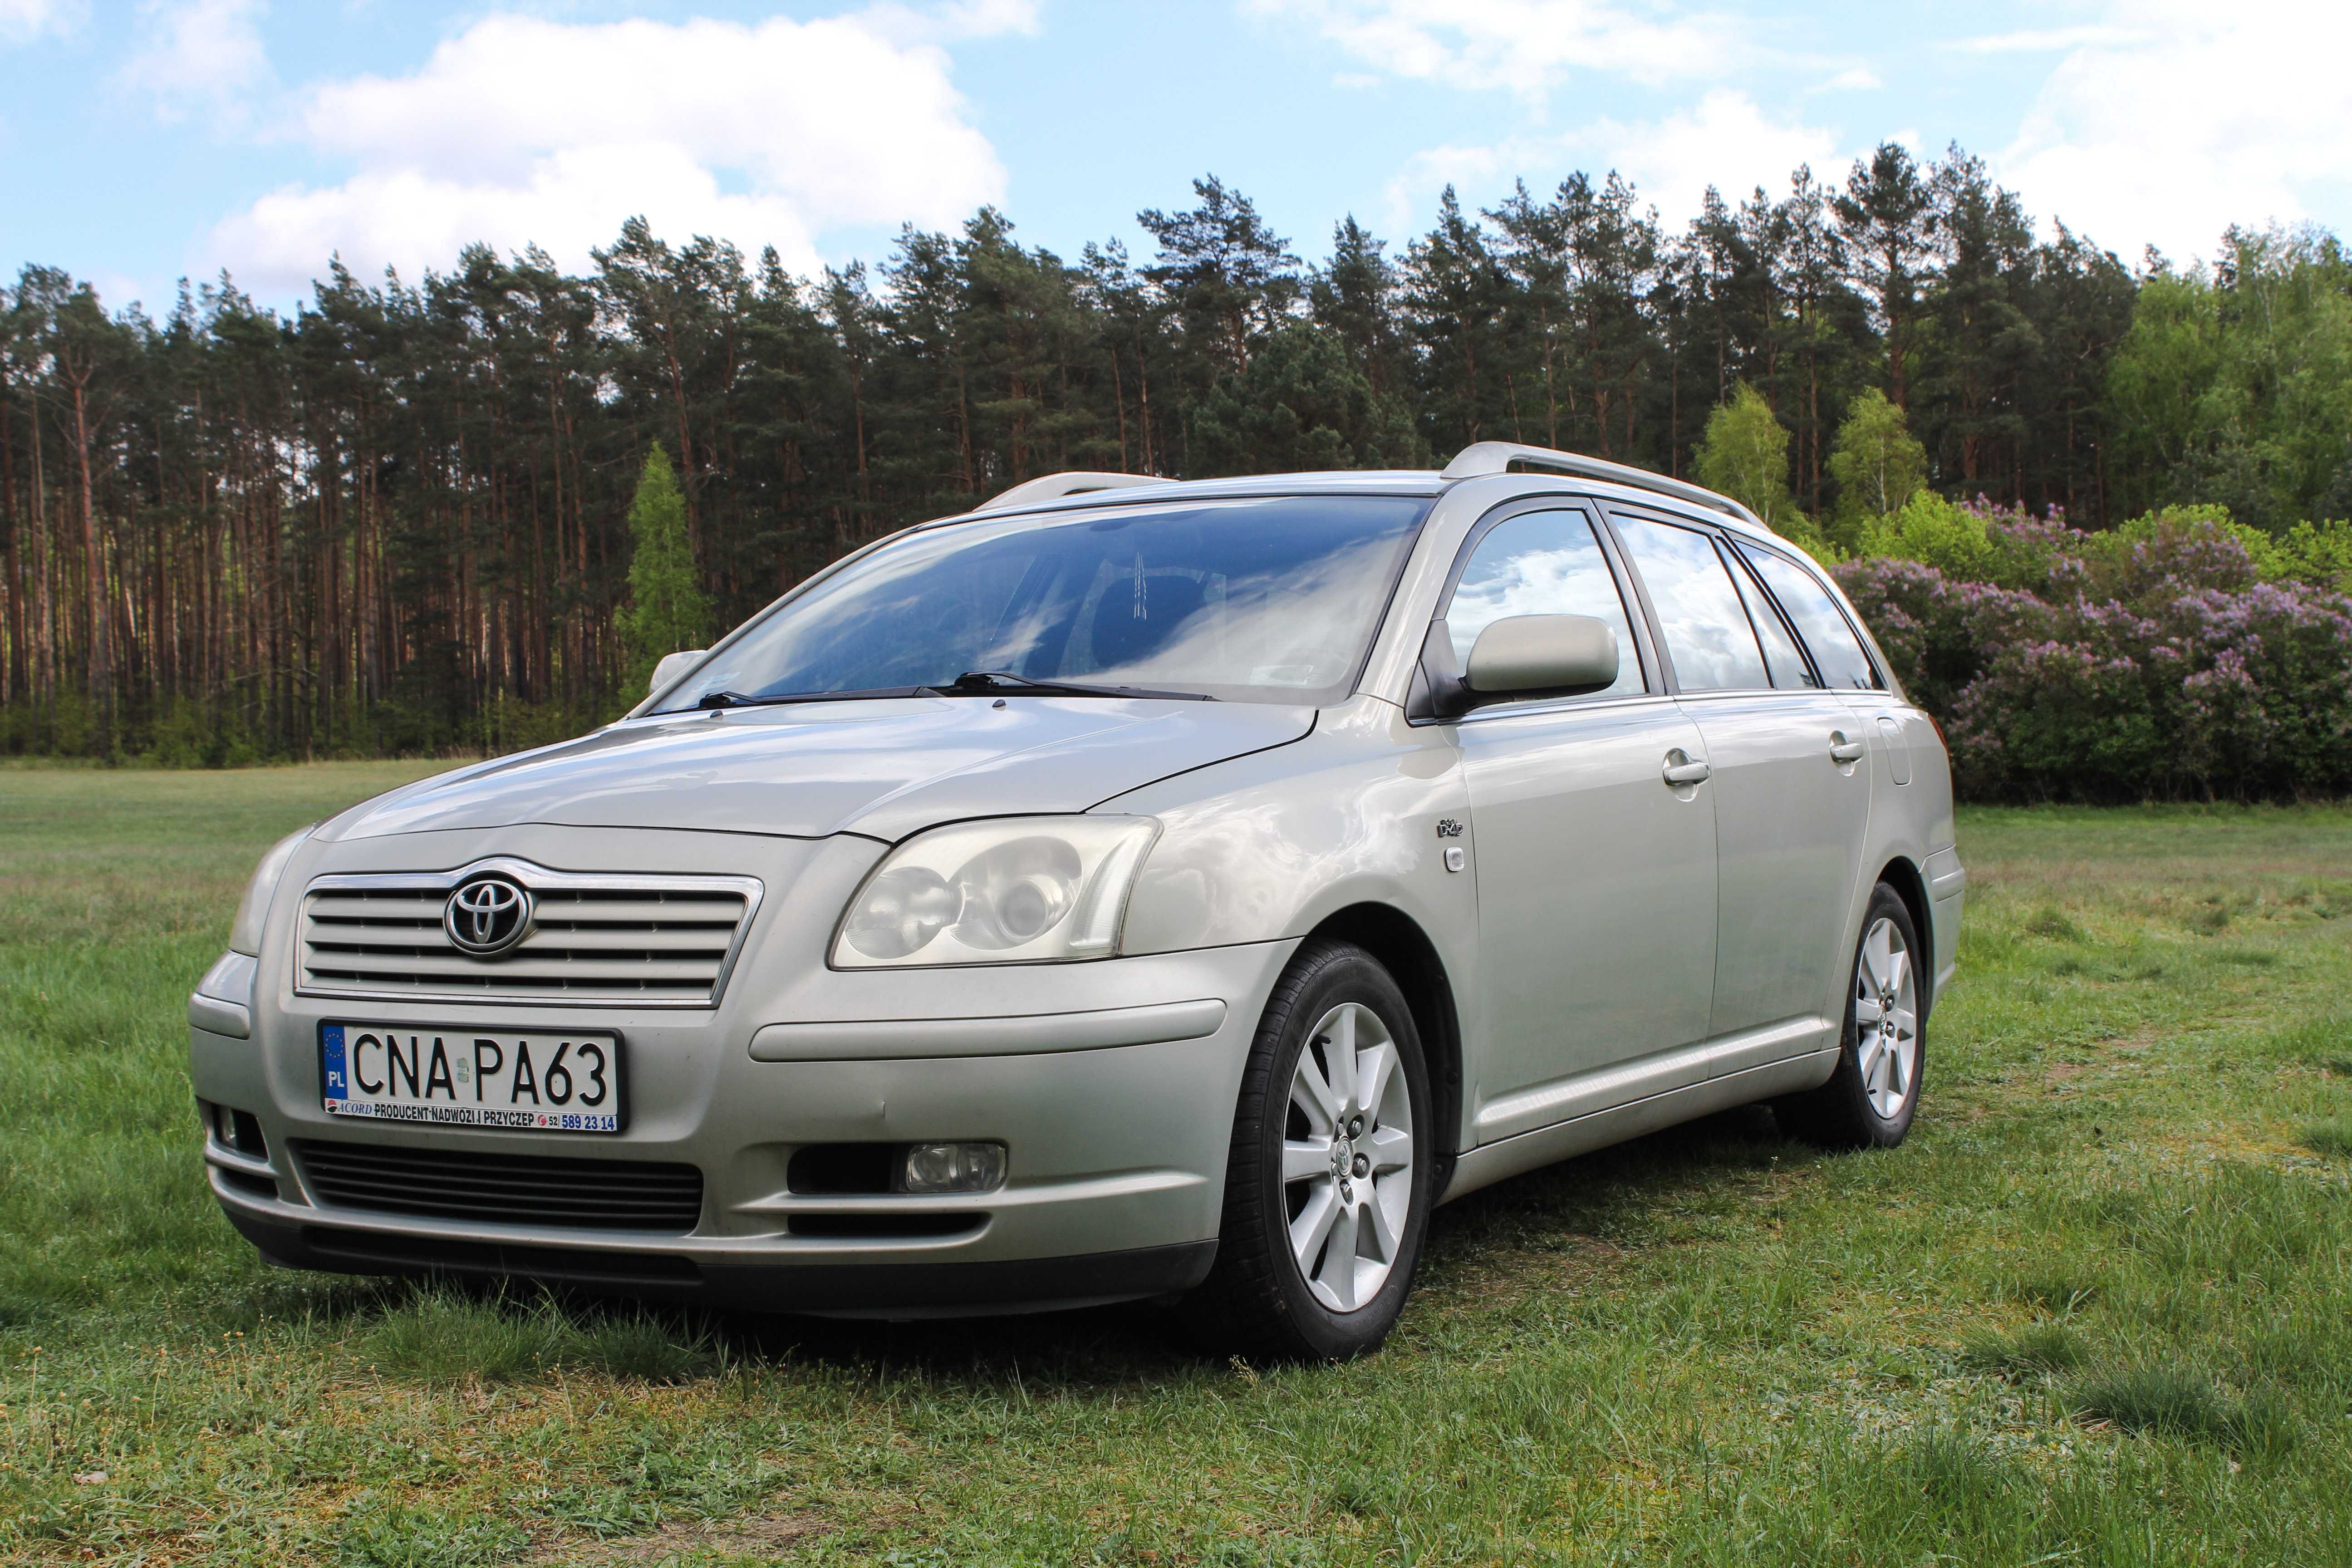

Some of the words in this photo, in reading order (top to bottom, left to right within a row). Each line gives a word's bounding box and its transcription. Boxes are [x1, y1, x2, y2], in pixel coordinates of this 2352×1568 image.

[328, 1071, 344, 1087] PL
[354, 1033, 457, 1100] CNA
[474, 1038, 607, 1106] PA63
[338, 1102, 372, 1115] ACORD
[375, 1103, 429, 1120] PRODUCENT
[432, 1107, 475, 1123] NADWOZI
[484, 1111, 534, 1126] PRZYCZEP
[562, 1115, 581, 1129] 589
[585, 1116, 598, 1130] 23
[601, 1116, 614, 1130] 14
